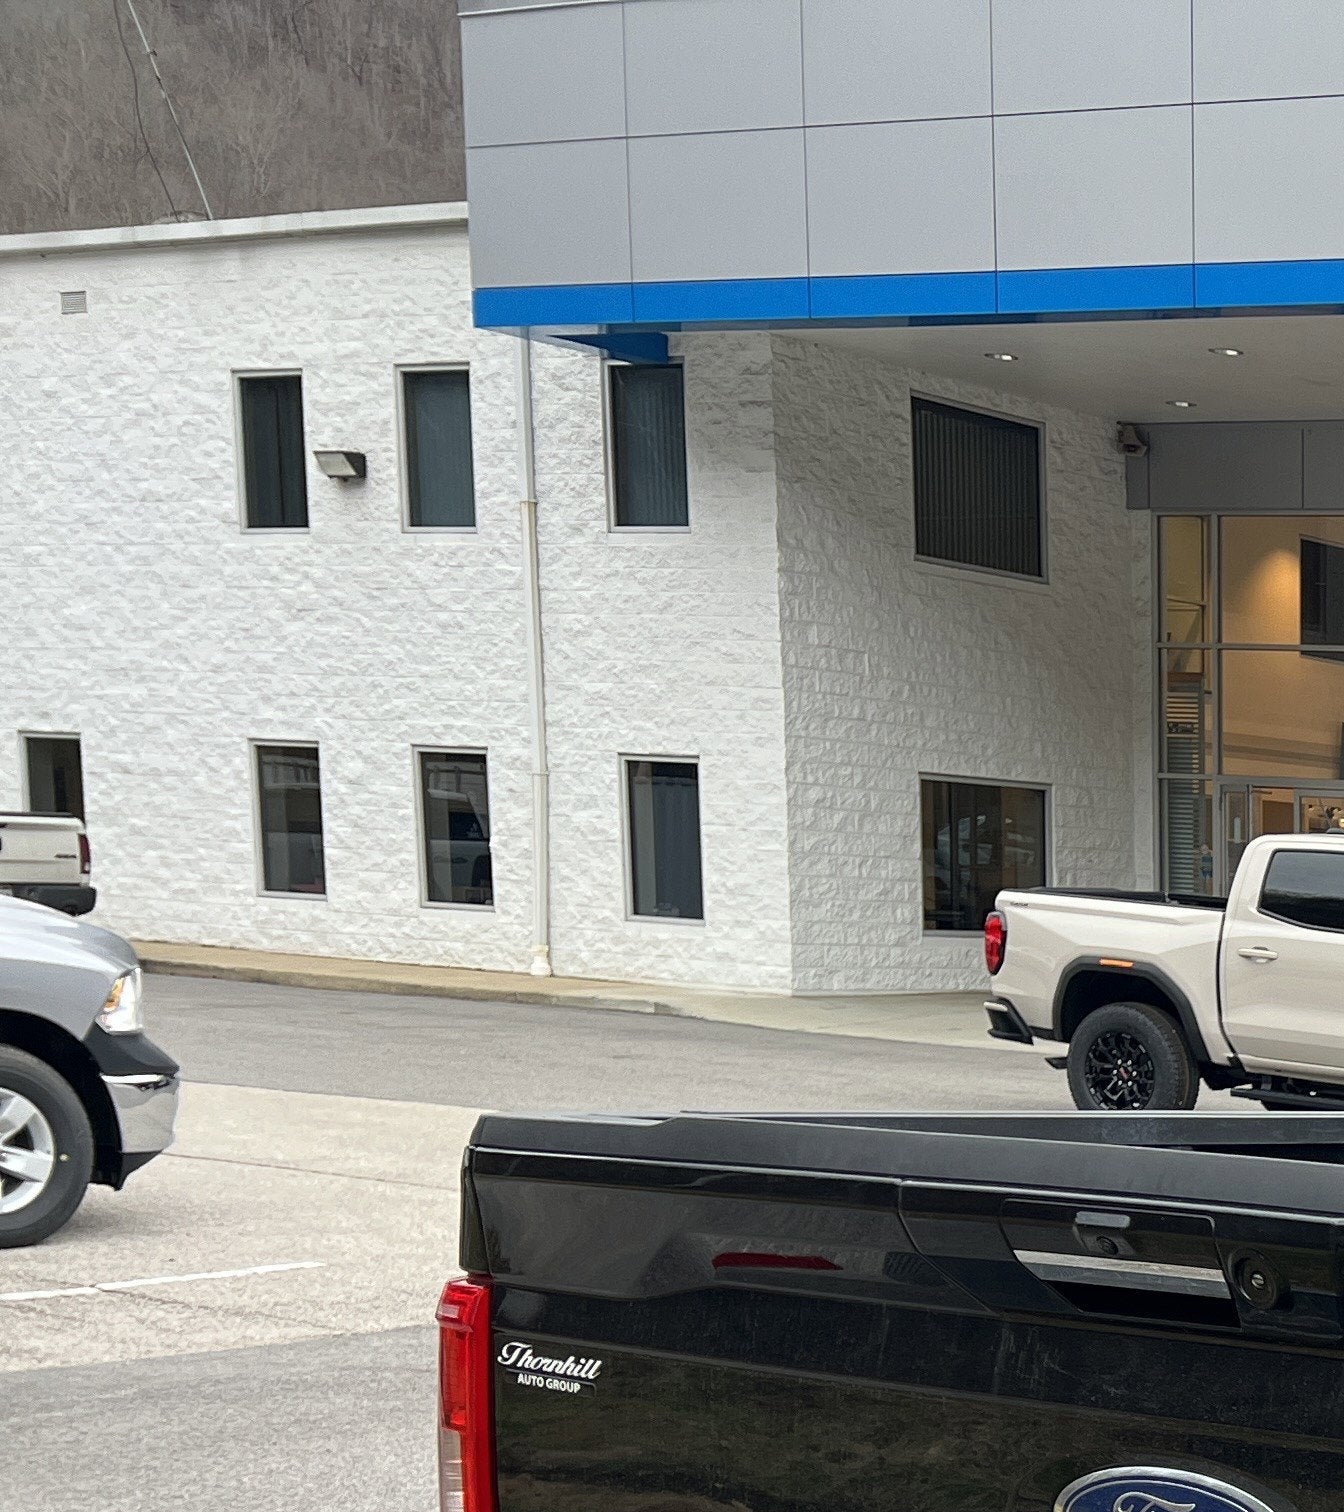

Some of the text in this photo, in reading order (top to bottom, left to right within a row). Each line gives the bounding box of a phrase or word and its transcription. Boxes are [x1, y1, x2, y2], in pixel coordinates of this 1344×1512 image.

[497, 1341, 602, 1379] Thornhill
[517, 1373, 581, 1394] AUTO GROUP
